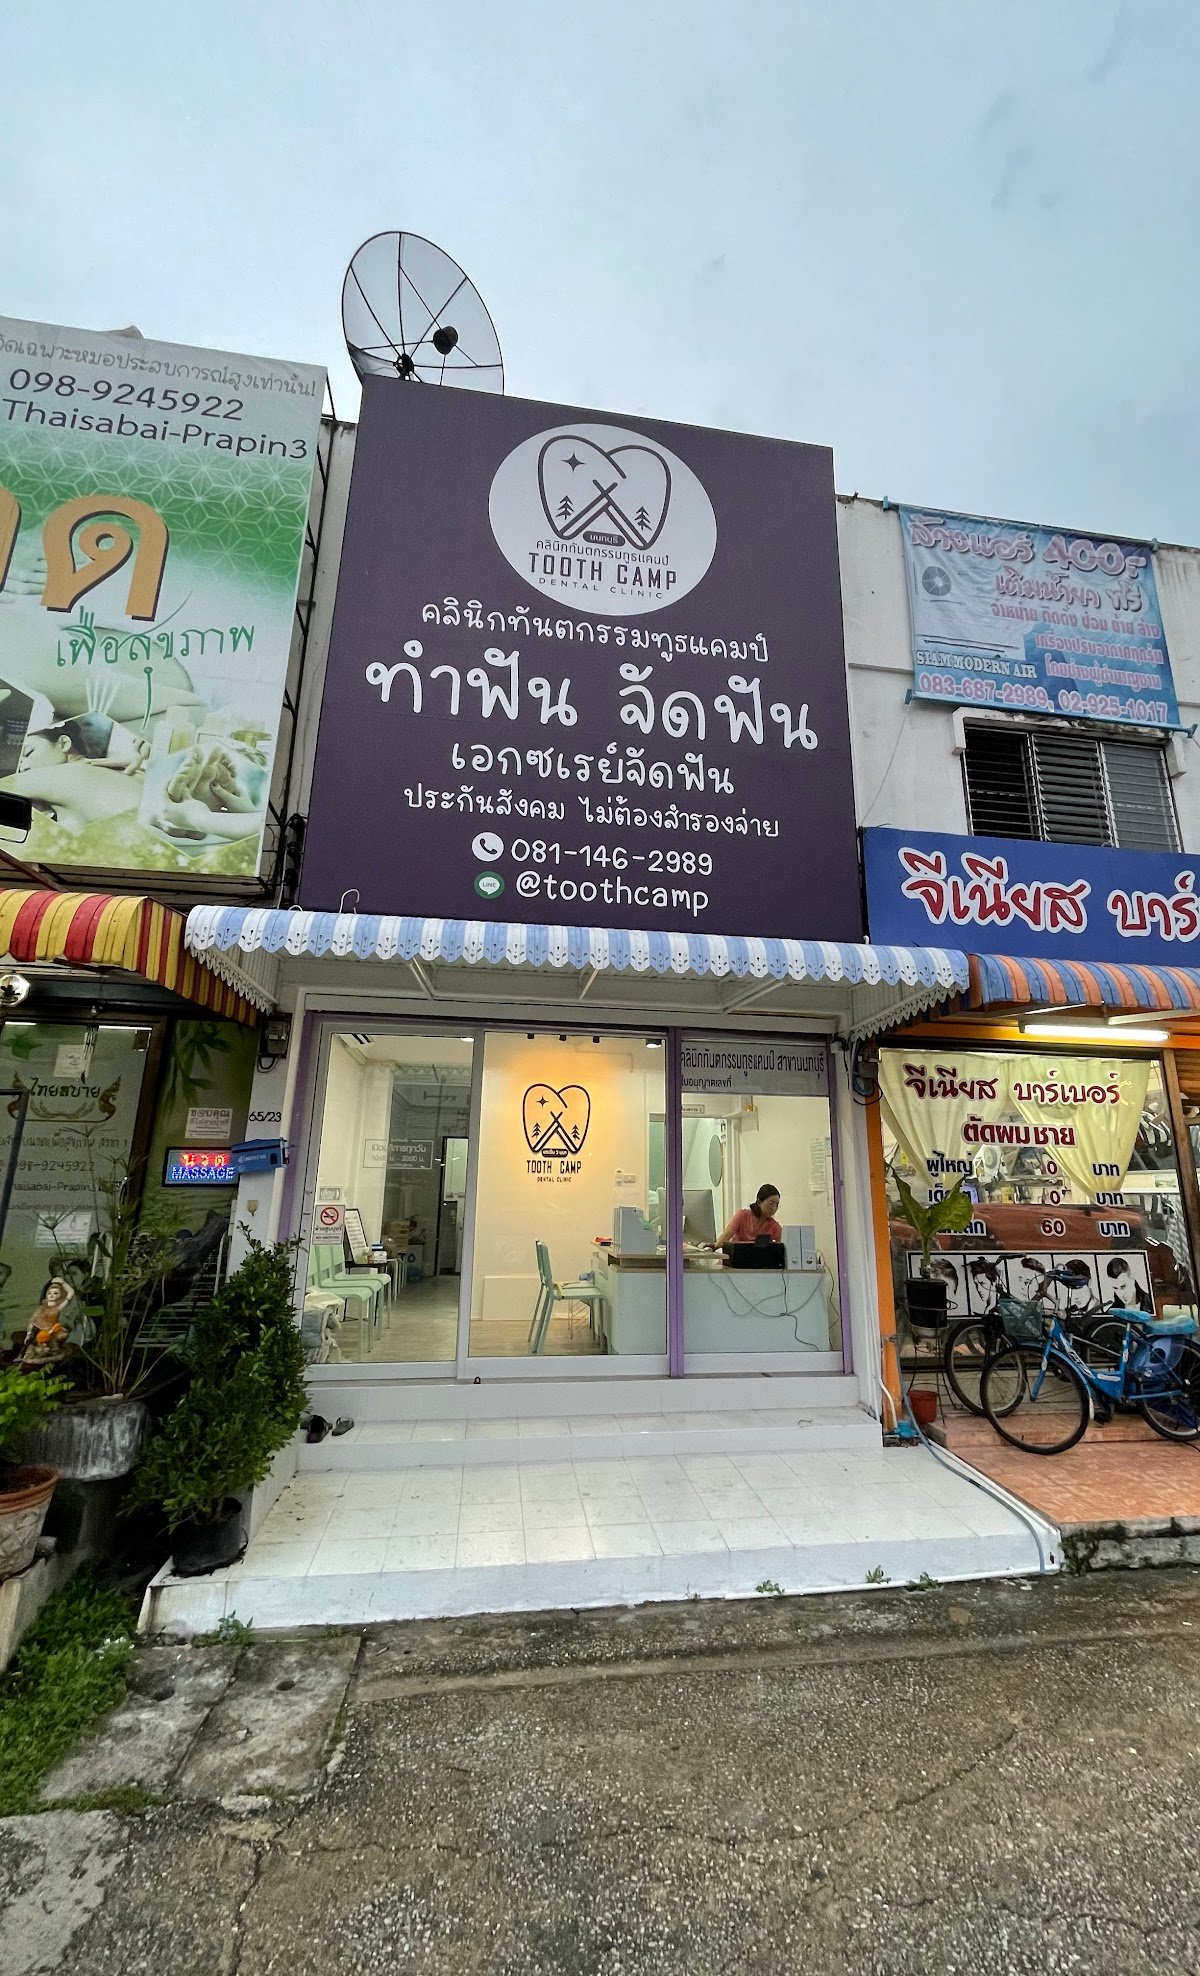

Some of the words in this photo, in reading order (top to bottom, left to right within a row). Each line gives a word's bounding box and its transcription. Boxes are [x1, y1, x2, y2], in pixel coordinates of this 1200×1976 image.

[9, 368, 244, 421] 098-9245922
[2, 399, 308, 459] Thaisabai-Prapin3
[528, 552, 602, 581] TOOTH
[616, 563, 677, 590] CAMP
[538, 577, 599, 592] DENTAL
[609, 586, 663, 599] CLINIC
[421, 597, 769, 663] คลินิกทันตกรรมทูธแคมป์
[56, 605, 254, 730] เพื่อสุขภาพ
[916, 650, 953, 668] SIAM
[954, 655, 1010, 676] MODERN
[1013, 664, 1038, 679] AIR
[365, 639, 578, 728] ทำฟัน
[618, 662, 819, 751] จัดฟัน
[1058, 689, 1168, 723] 02-925-1017
[451, 742, 735, 795] เอกซเรย์จัดฟัน
[403, 782, 566, 822] ประกันสังคม
[578, 795, 780, 838] ไม่ต้องสำรองจ่าย
[511, 837, 713, 876] 081-146-2989
[515, 869, 709, 917] @toothcamp
[900, 849, 1090, 932] จีเนียส
[903, 1062, 999, 1100] จีเนียส
[1013, 1069, 1120, 1105] บาร์เบอร์
[248, 1111, 282, 1123] 65/23
[172, 1166, 235, 1180] MASSAGE
[527, 1160, 552, 1173] TOOTH
[560, 1160, 582, 1174] CAMP
[1092, 1163, 1120, 1177] บาท
[1096, 1192, 1124, 1206] บาท
[1041, 1219, 1065, 1235] 60
[1100, 1222, 1129, 1236] บาท
